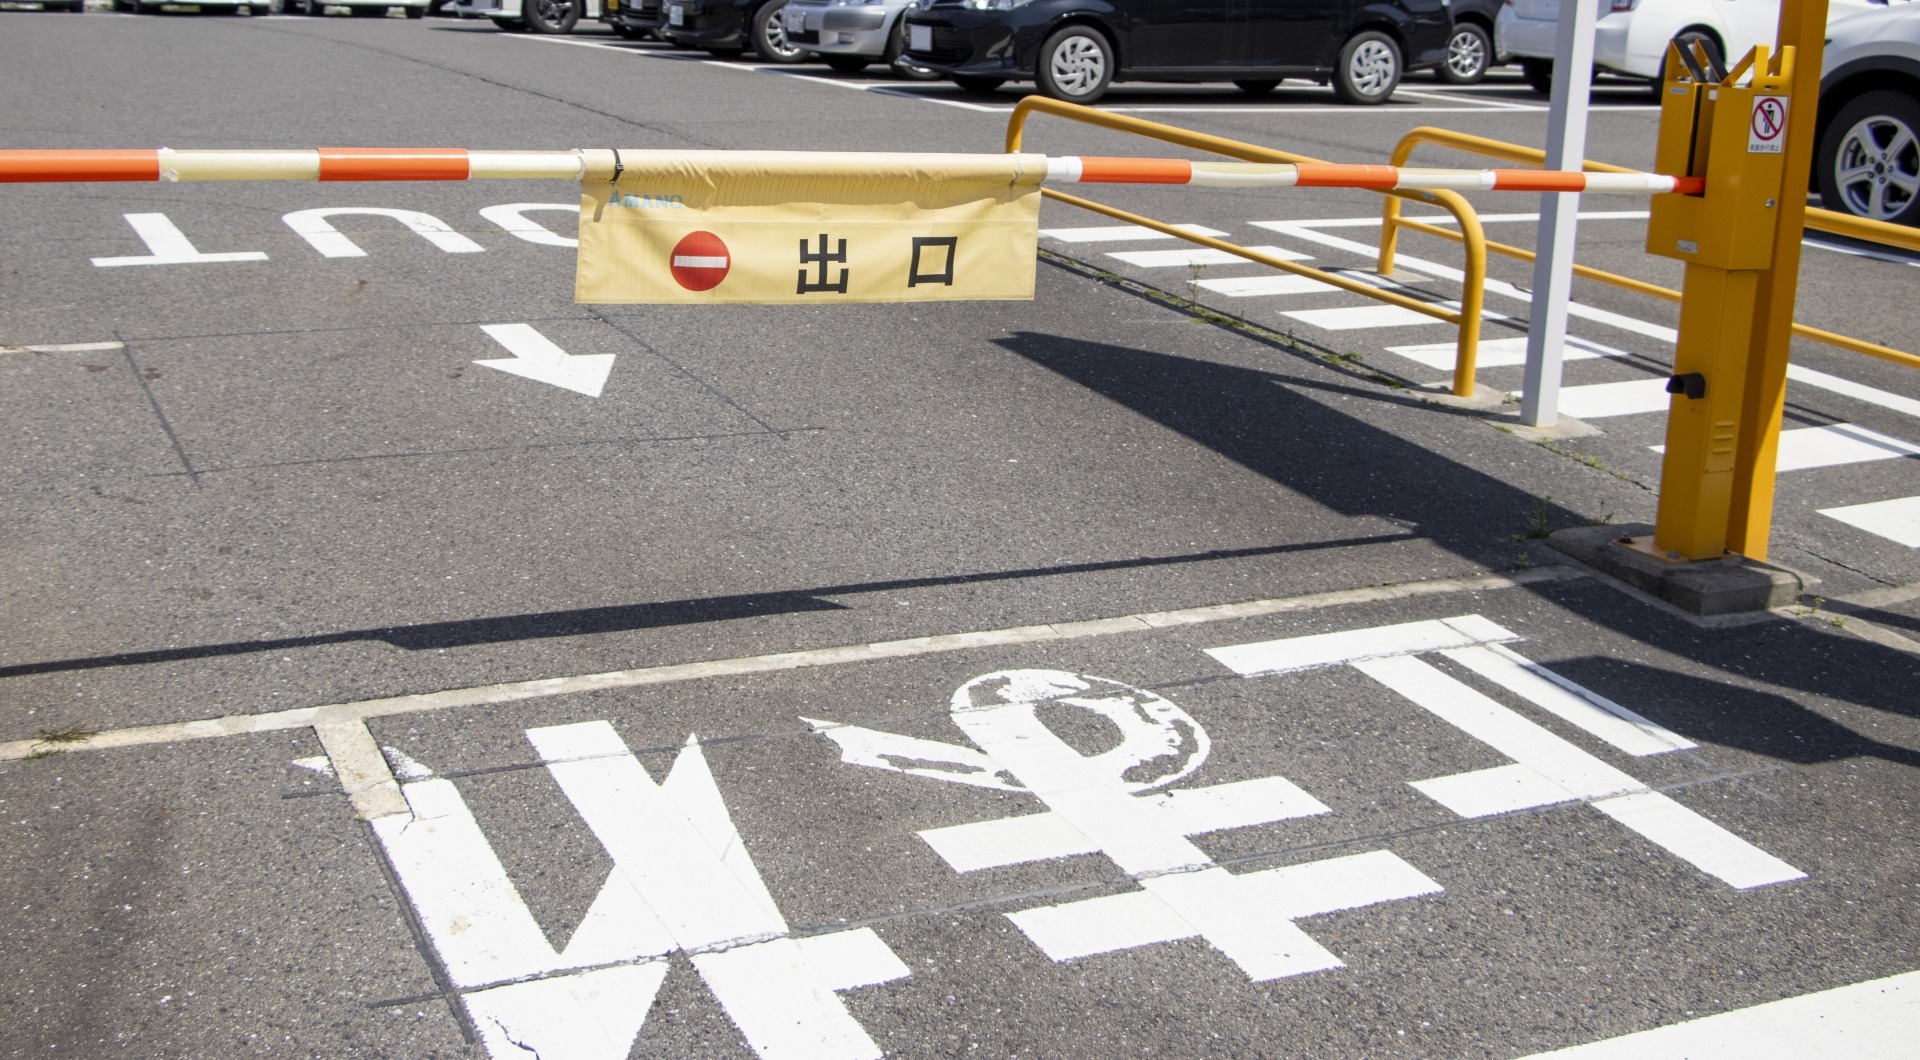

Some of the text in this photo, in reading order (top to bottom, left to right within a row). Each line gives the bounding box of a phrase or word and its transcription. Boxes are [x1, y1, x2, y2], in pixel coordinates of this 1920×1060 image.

[607, 191, 684, 209] AMANO
[796, 233, 958, 294] 出口
[291, 613, 1807, 1060] 止まれ
